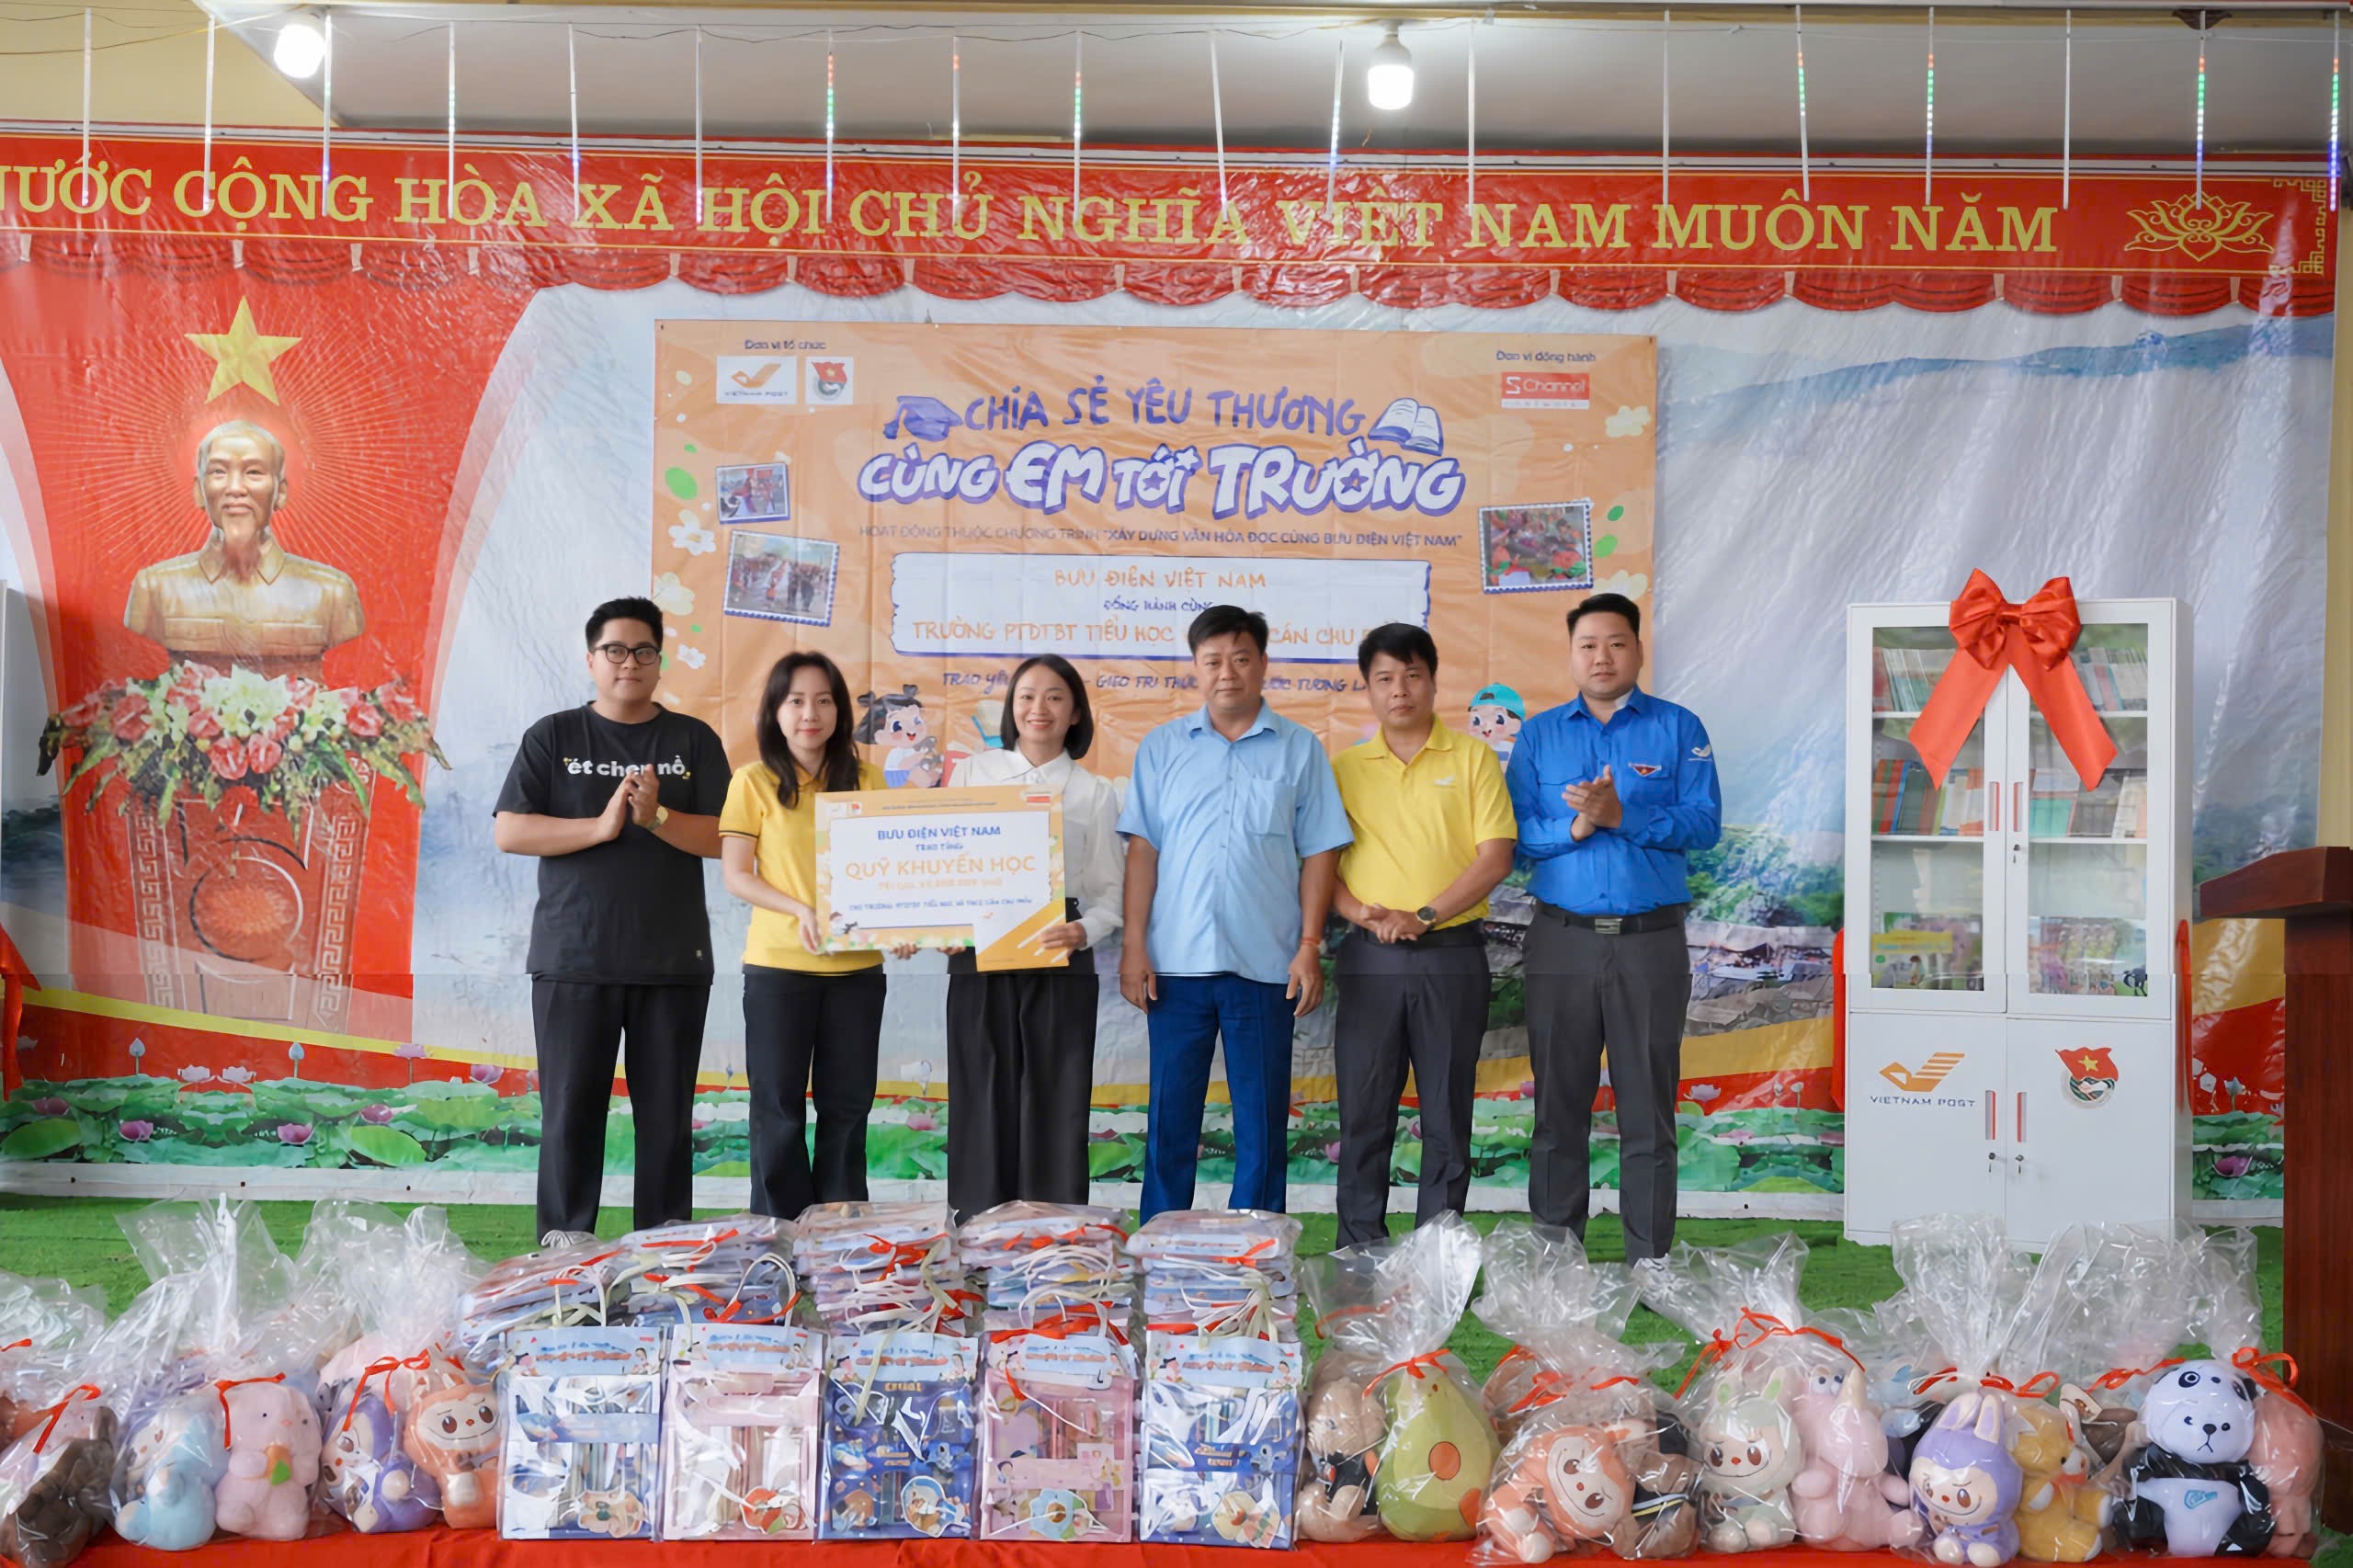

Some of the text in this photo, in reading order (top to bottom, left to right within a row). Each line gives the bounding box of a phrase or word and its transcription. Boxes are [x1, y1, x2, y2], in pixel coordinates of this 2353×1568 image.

[174, 156, 372, 231] CỘNG
[394, 164, 547, 228] HÒA
[576, 175, 674, 232] XÃ
[697, 173, 826, 246] HỘI
[850, 171, 994, 239] CHỦ
[1017, 189, 1250, 246] NGHĨA
[1467, 204, 1630, 249] NAM
[1653, 188, 1870, 251] MUÔN
[1892, 192, 2058, 253] NĂM
[1063, 374, 1109, 426] SẺ
[1126, 378, 1192, 426] YÊU
[1207, 386, 1366, 436] THƯƠNG
[858, 442, 1001, 505] CÙNG
[1003, 439, 1108, 515] EM
[1208, 437, 1466, 520] TRƯỜNG
[1218, 572, 1267, 588] NAM
[912, 615, 997, 641] TRƯỜNG
[1005, 622, 1077, 642] PTDTBT
[1085, 614, 1128, 642] TIỂU
[1315, 626, 1354, 645] CHU
[971, 825, 1001, 836] NAM
[897, 852, 984, 876] KHUYẾN
[990, 855, 1036, 876] HỌC
[1870, 1096, 1976, 1108] VIETNAM POST
